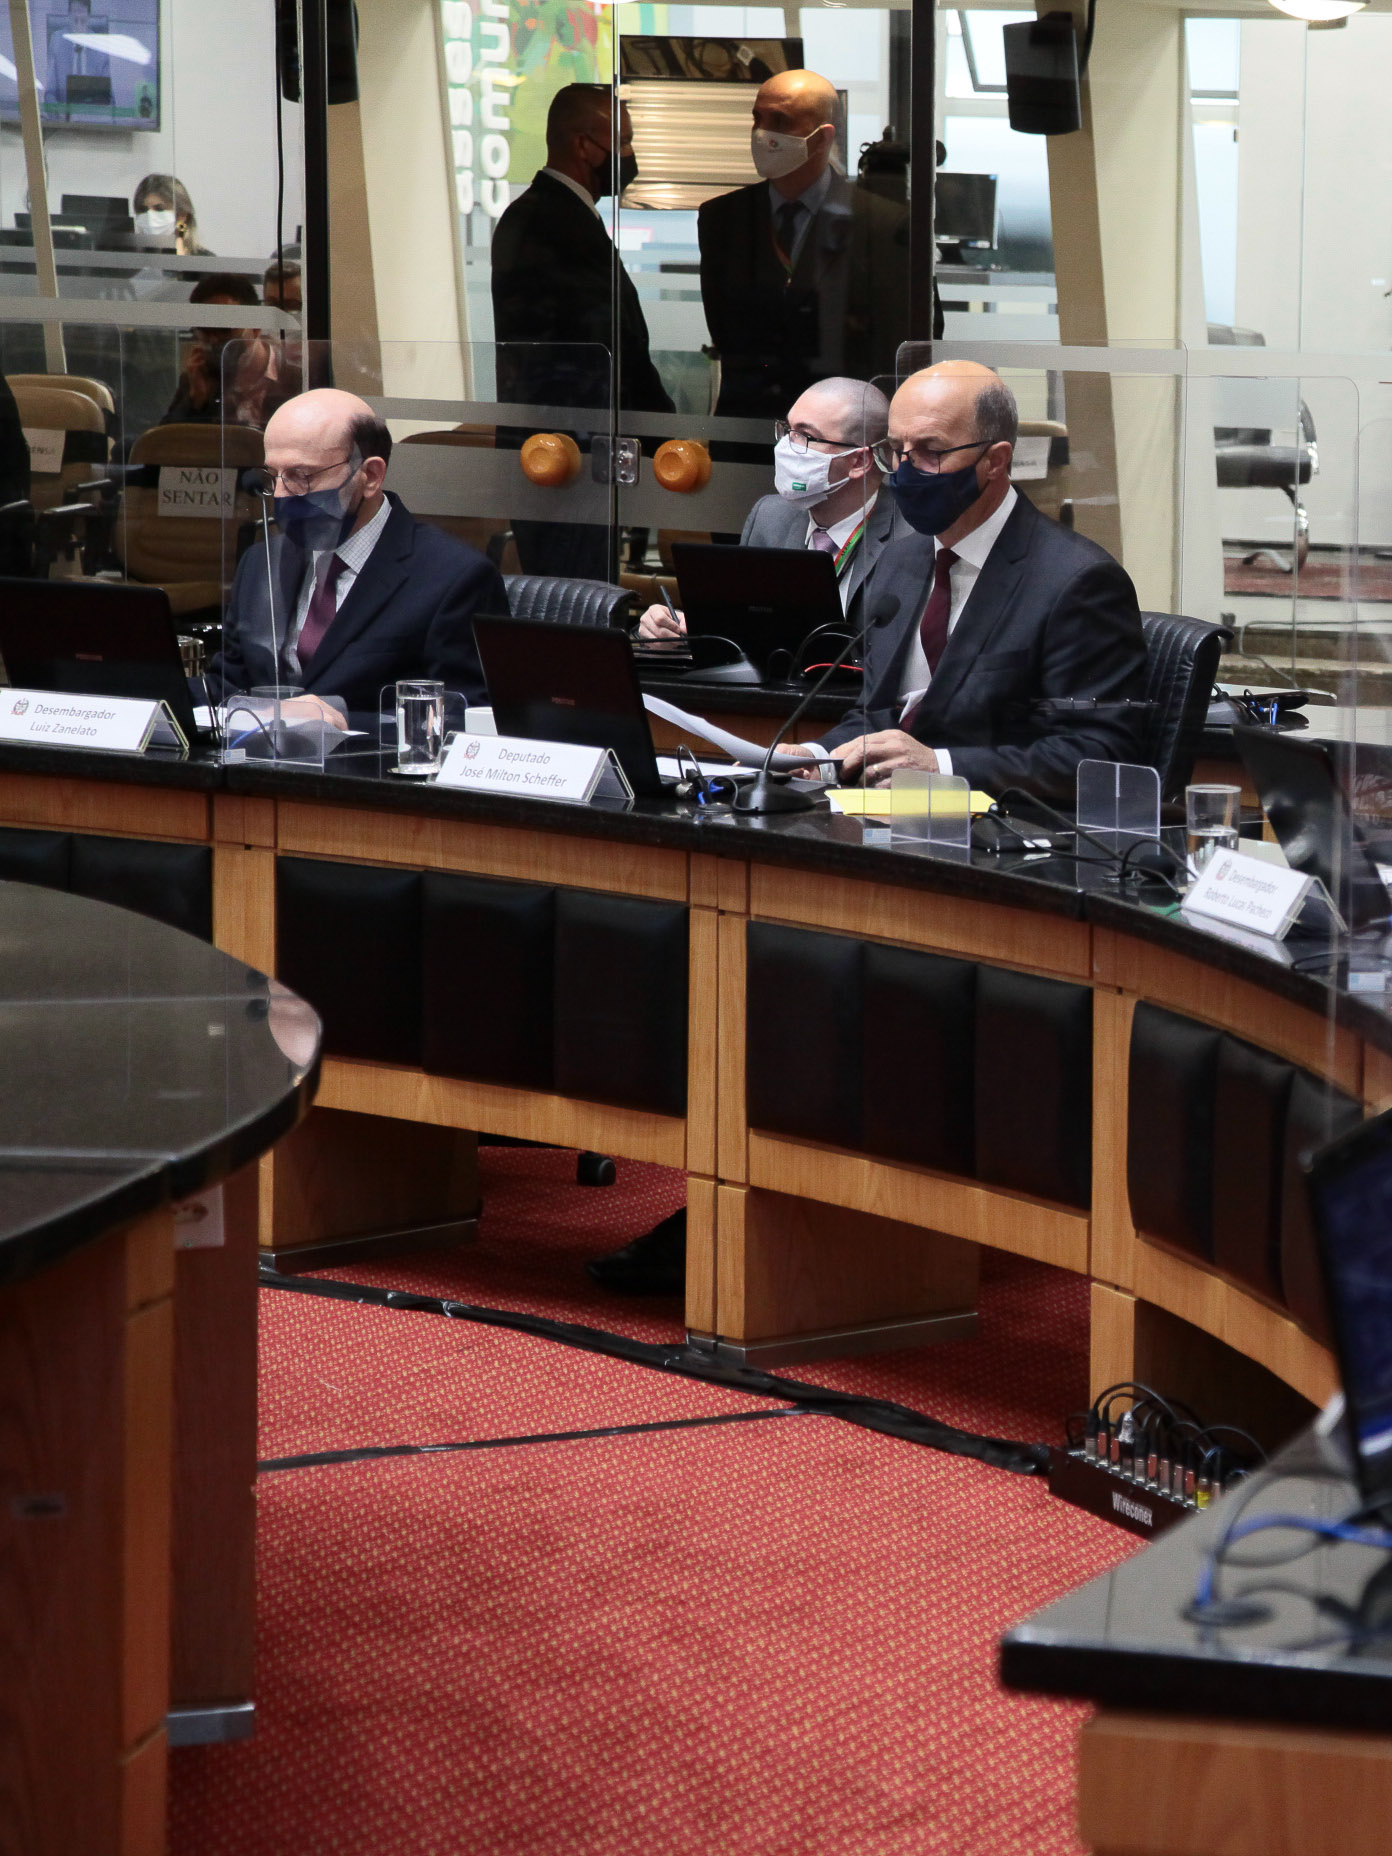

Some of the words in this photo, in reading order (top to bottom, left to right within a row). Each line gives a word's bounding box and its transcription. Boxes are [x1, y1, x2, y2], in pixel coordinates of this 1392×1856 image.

[179, 468, 220, 486] NÃO
[162, 490, 232, 506] SENTAR
[34, 704, 116, 720] Desembargador
[30, 722, 49, 733] Luiz
[52, 723, 98, 737] Zanelato
[498, 748, 551, 765] Deputado
[460, 765, 485, 778] José
[485, 768, 520, 783] Milton
[522, 772, 568, 788] Scheffer
[1112, 1491, 1153, 1527] Wireconex
